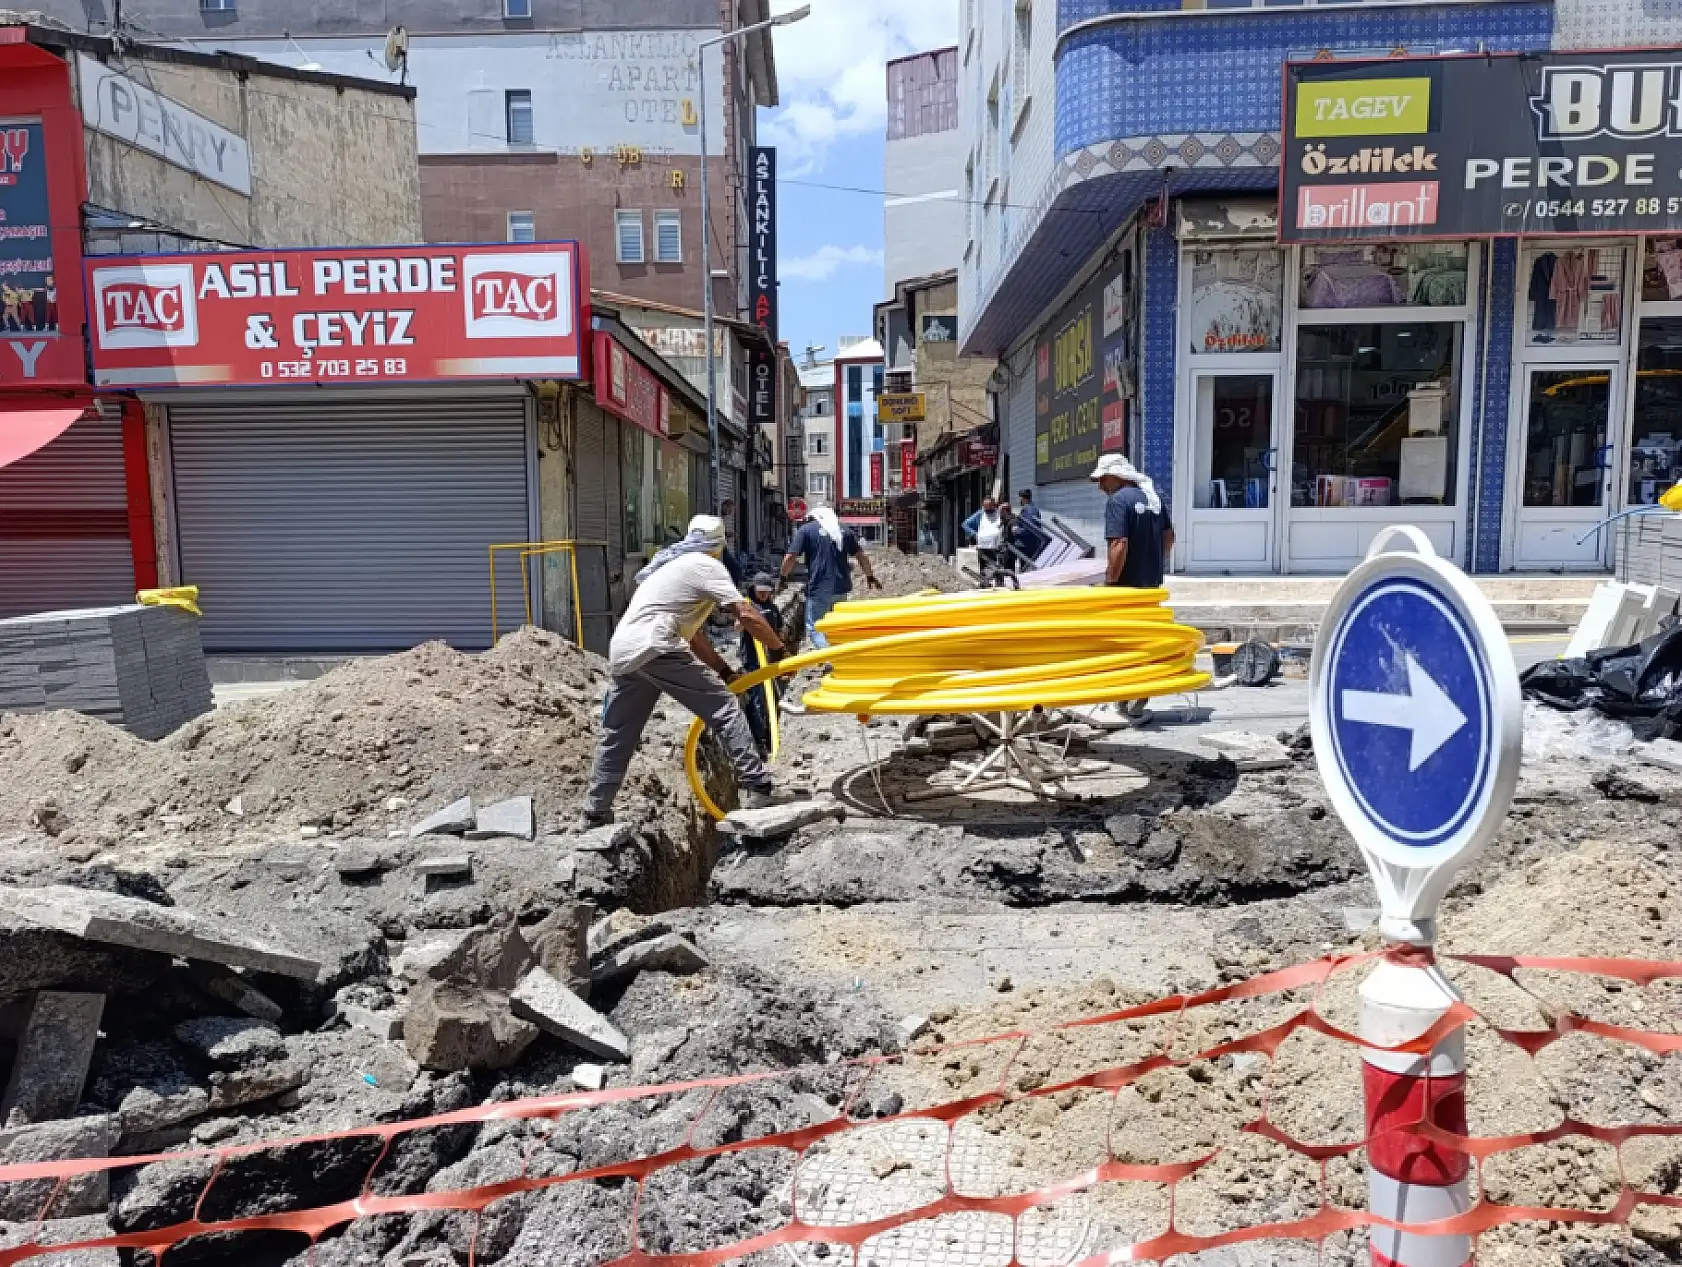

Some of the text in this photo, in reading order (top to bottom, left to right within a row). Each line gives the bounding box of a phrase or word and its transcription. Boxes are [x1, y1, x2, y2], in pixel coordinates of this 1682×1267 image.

[1314, 95, 1412, 121] TAGEV
[1530, 63, 1682, 140] BU
[1301, 143, 1438, 175] Özdilek
[1465, 153, 1656, 190] PERDE
[1303, 184, 1431, 229] brillant
[1535, 200, 1585, 219] 0544
[1591, 199, 1630, 217] 527
[1635, 198, 1661, 216] 88
[313, 257, 456, 295] PERDE
[475, 277, 553, 322] TAÇ
[245, 312, 279, 350] &
[261, 358, 407, 378] 0 532 703 25 83
[756, 365, 769, 416] OTEL
